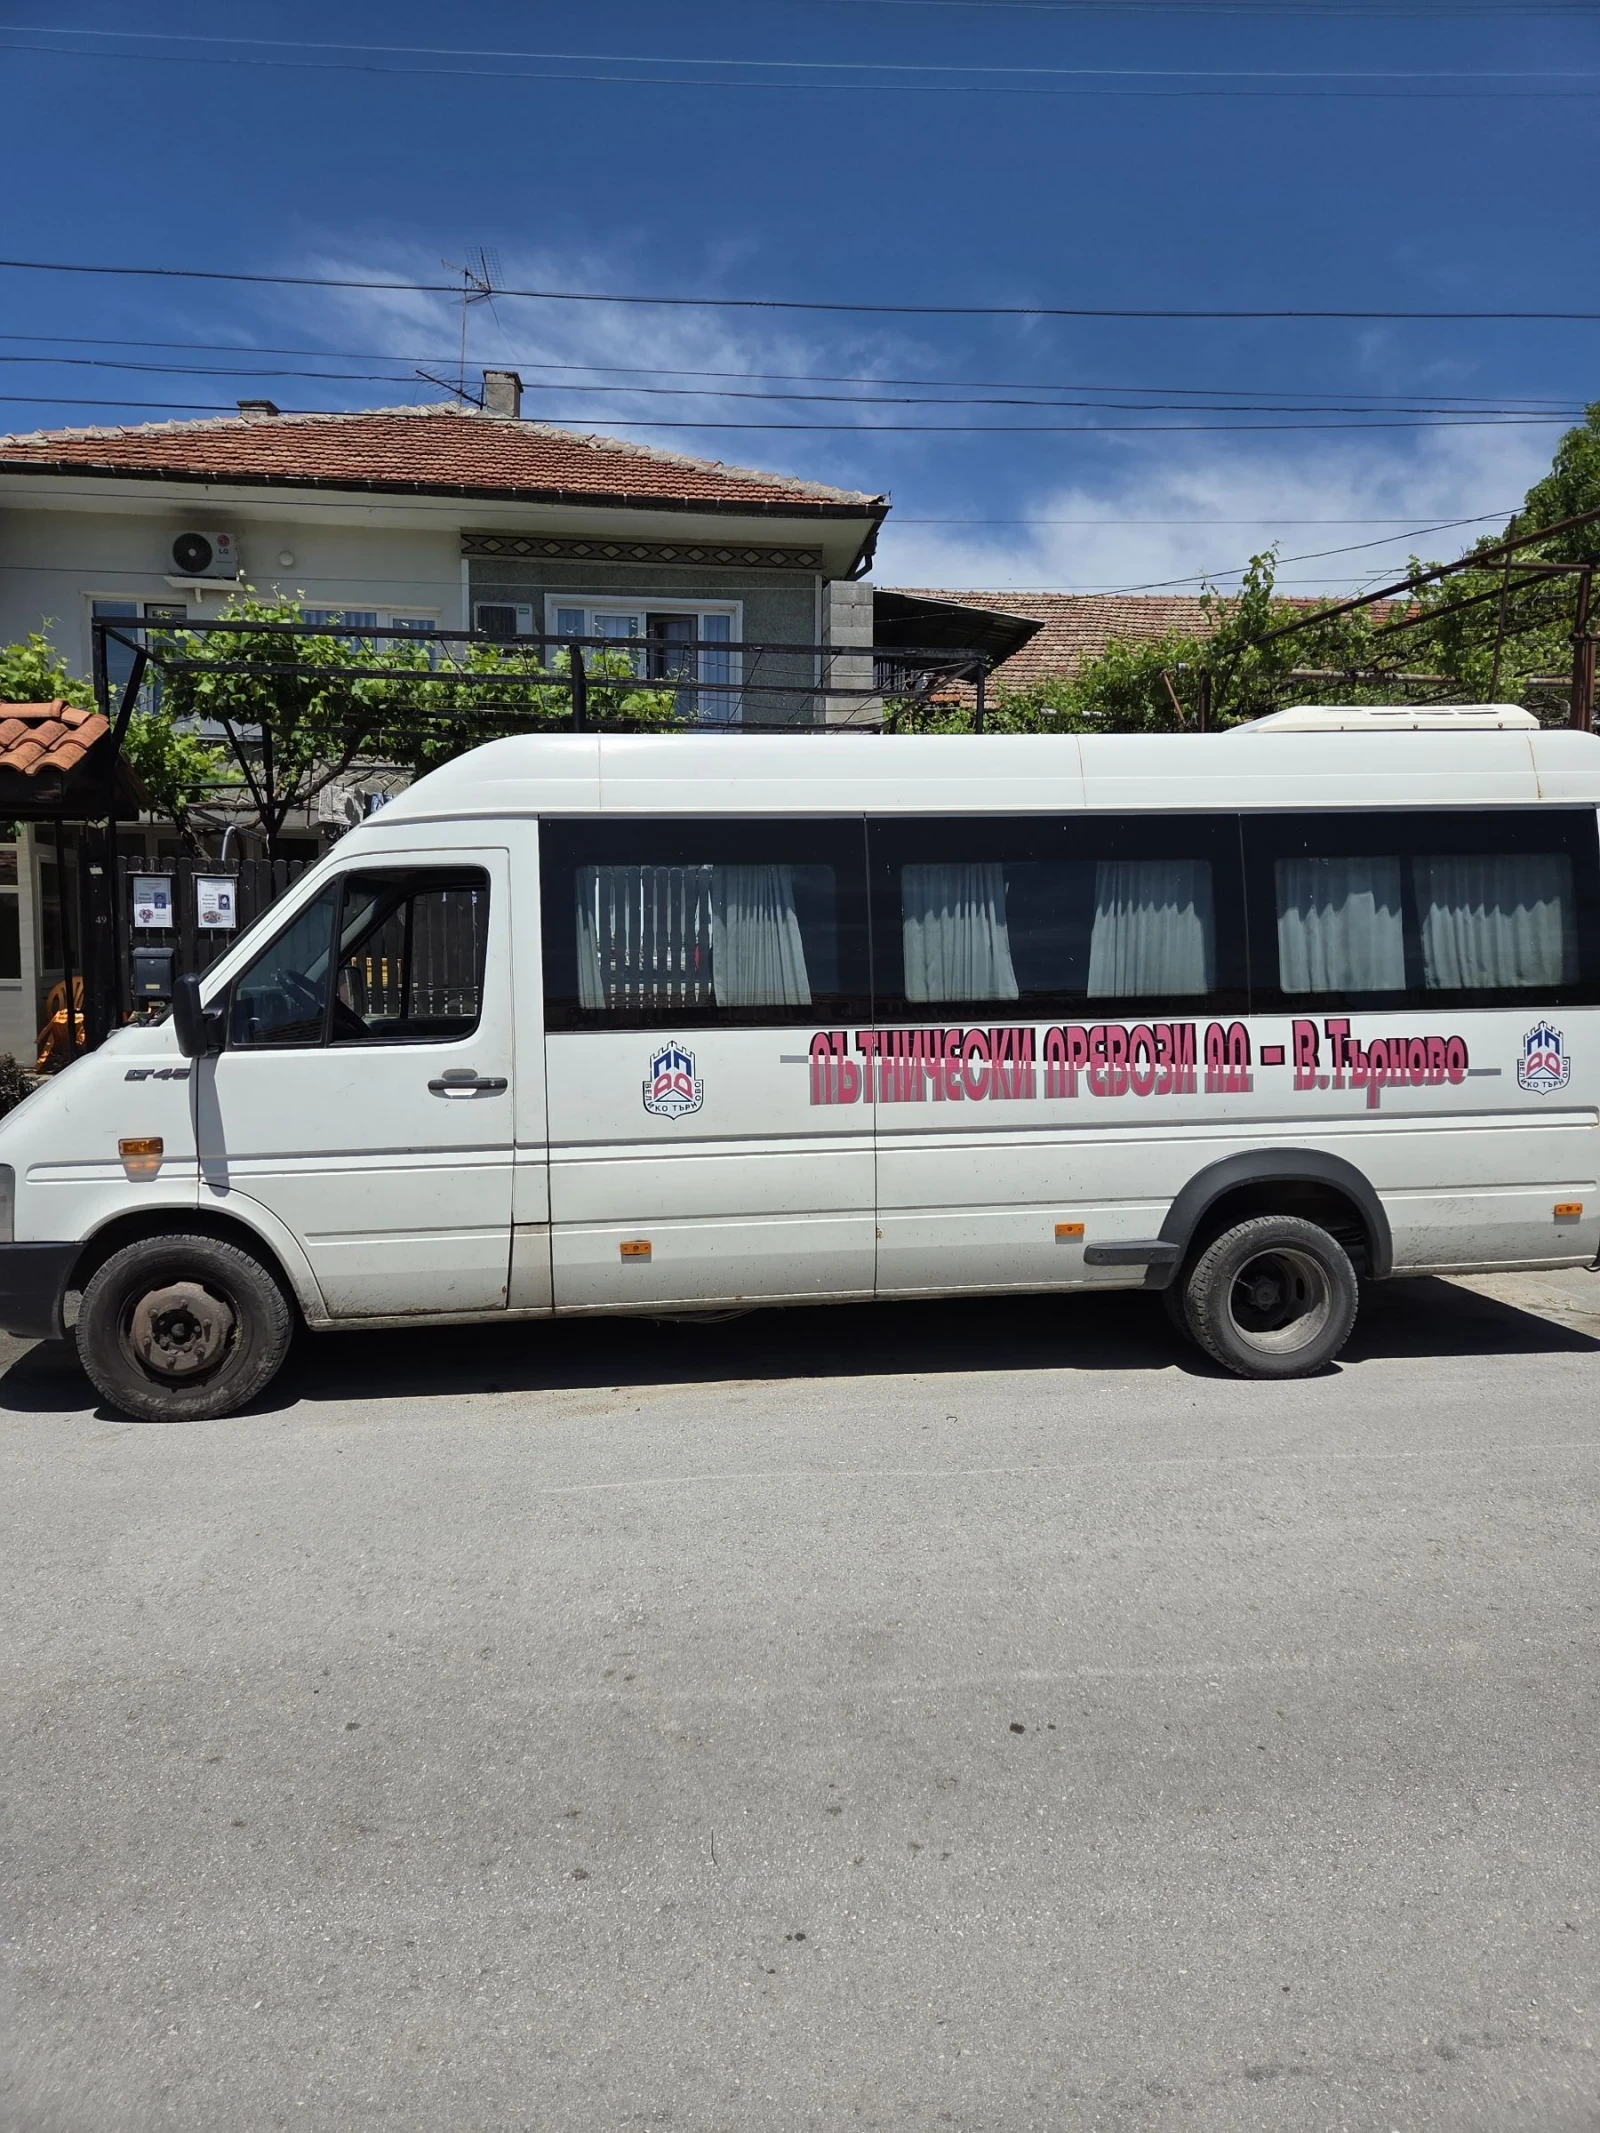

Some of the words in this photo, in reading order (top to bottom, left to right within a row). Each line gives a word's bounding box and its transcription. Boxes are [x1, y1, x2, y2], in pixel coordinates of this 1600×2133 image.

[218, 547, 230, 555] LG
[809, 1027, 1037, 1105] ПЪТНИЧЕСКИ
[1043, 1023, 1197, 1098] ПРЕВОЗИ
[1204, 1021, 1254, 1093] АД
[1519, 1061, 1539, 1088] ВЕЛИКО
[1542, 1059, 1568, 1088] ТЪРНОВО
[645, 1084, 668, 1111] ВЕЛИКО
[673, 1082, 701, 1111] ТЪРНОВО
